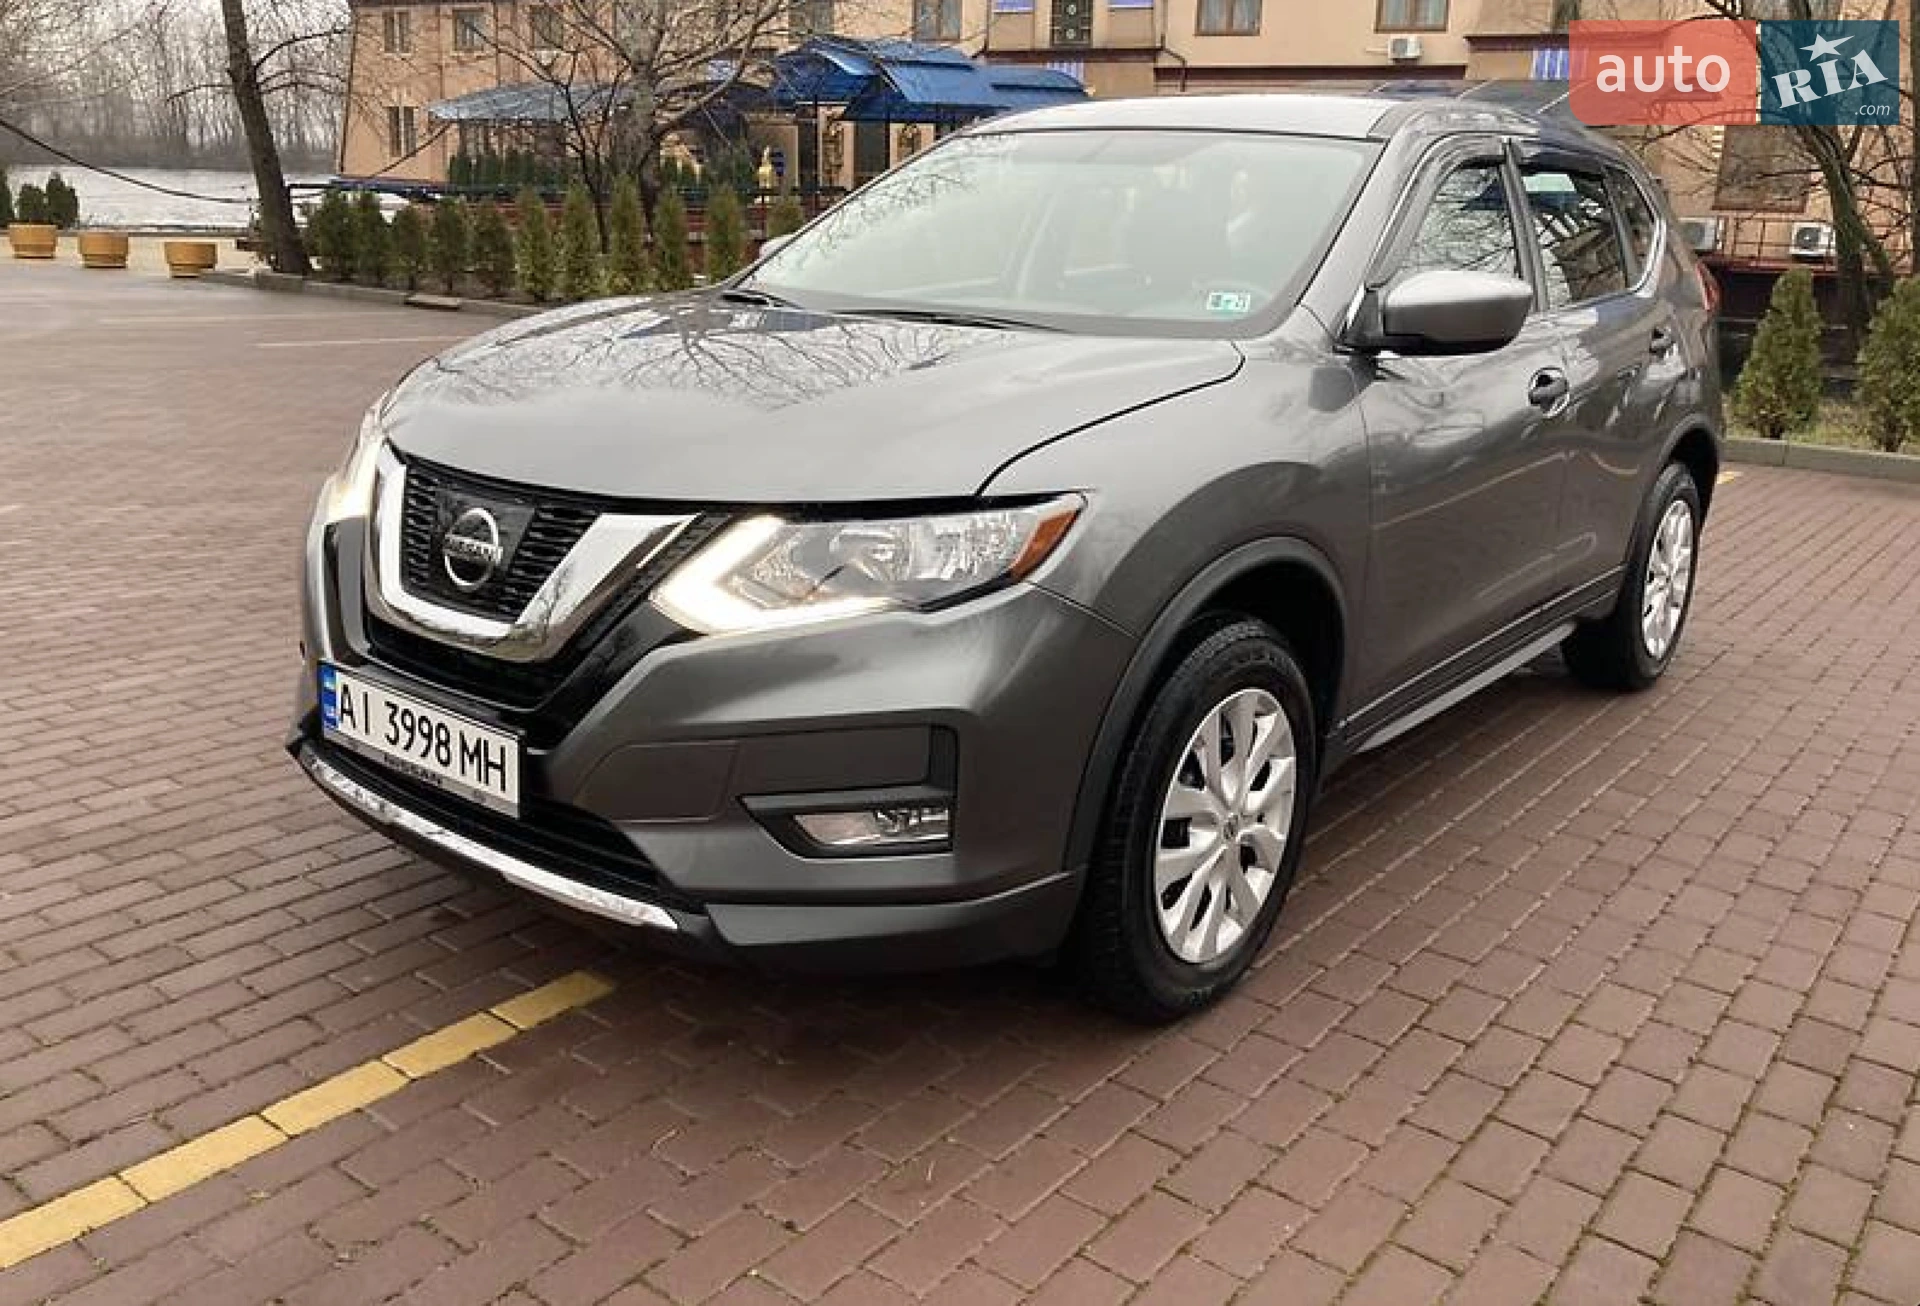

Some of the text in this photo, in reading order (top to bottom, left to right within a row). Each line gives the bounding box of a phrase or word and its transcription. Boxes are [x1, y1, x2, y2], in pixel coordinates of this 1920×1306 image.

[340, 684, 506, 792] AI 3998 MH
